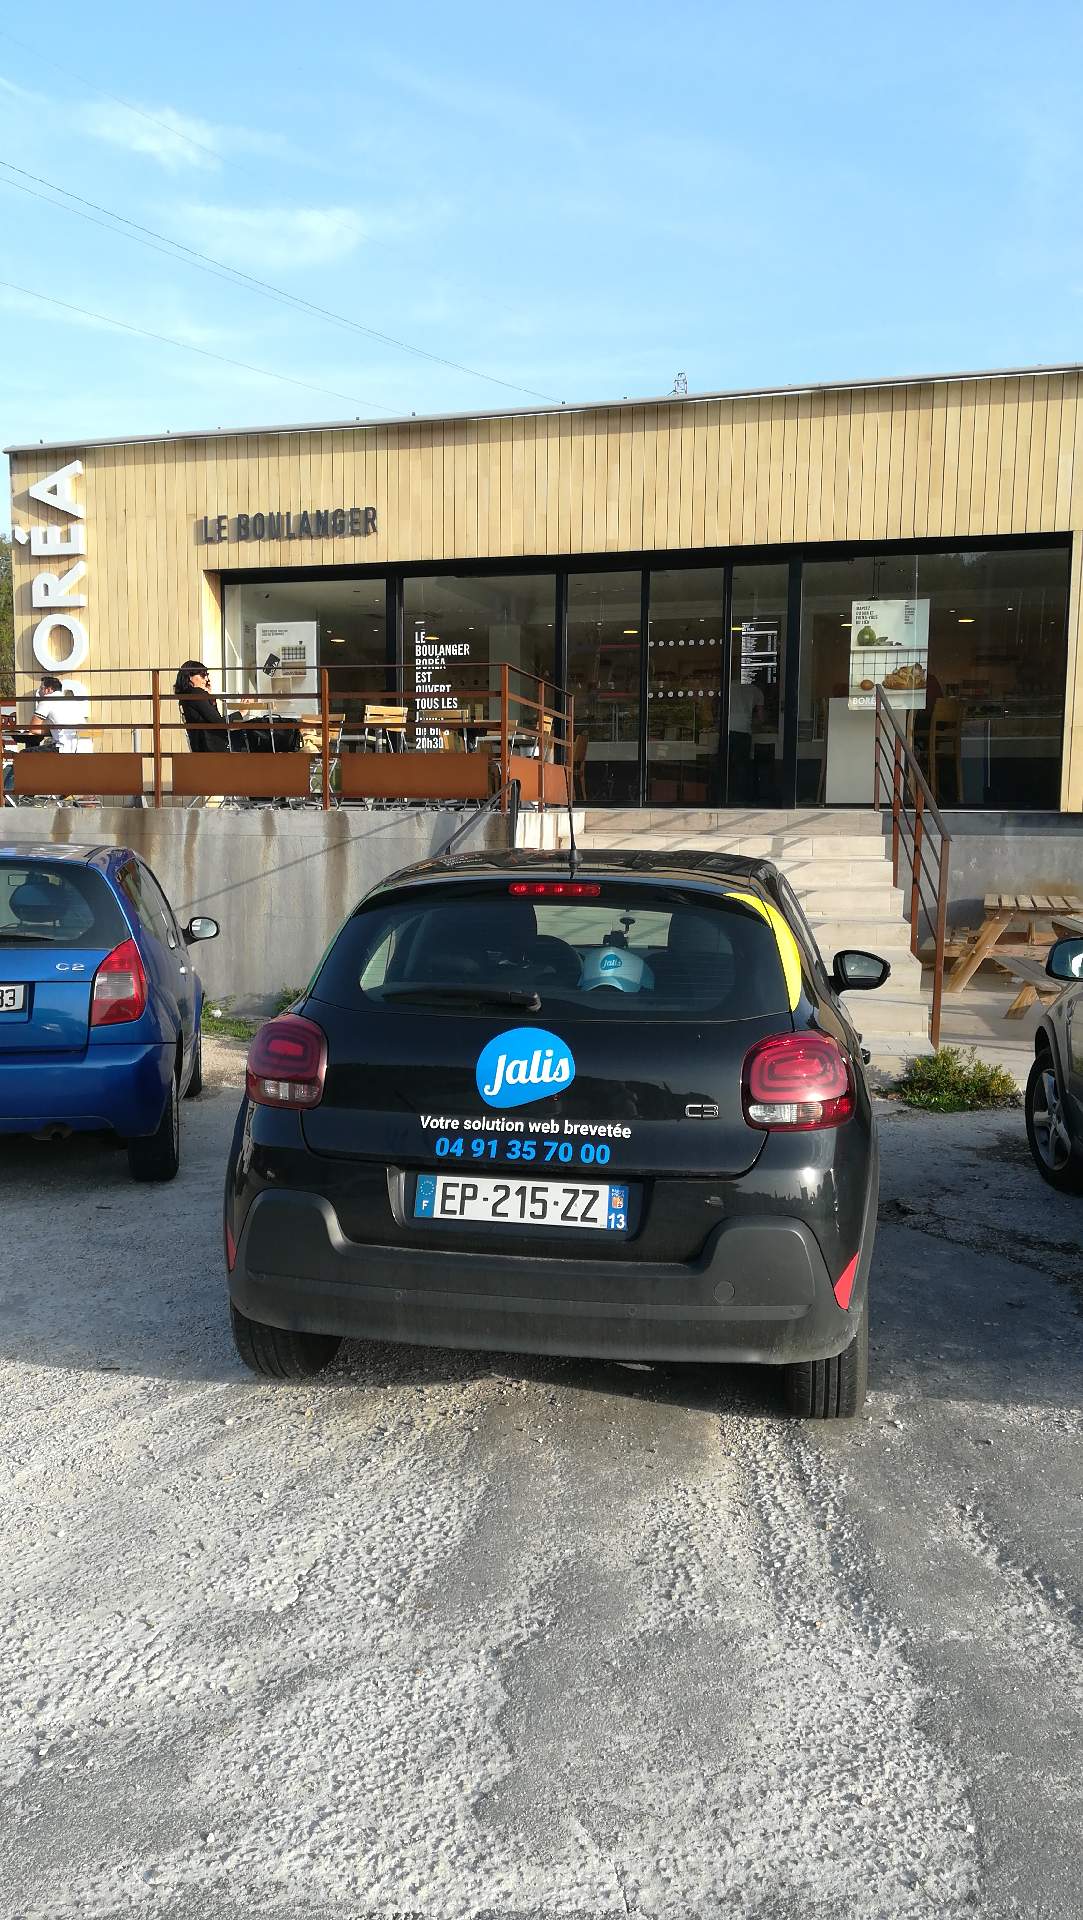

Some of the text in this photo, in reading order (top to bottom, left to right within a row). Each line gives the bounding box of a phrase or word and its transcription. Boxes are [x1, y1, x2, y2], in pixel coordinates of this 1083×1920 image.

[203, 506, 378, 542] LE BOULANGER
[15, 459, 88, 724] ORÉA
[415, 631, 426, 644] LE
[415, 643, 470, 657] BOULANGER
[415, 655, 447, 670] BORÉA
[415, 671, 433, 683] EST
[415, 697, 458, 710] TOUS LES
[415, 736, 444, 749] 20h30
[55, 962, 85, 971] C2
[483, 1048, 570, 1097] Jalis
[685, 1104, 719, 1118] C3
[420, 1115, 632, 1139] Votre solution web brevetée
[435, 1137, 611, 1165] 04 91 35 70 00
[422, 1200, 430, 1210] F
[439, 1182, 600, 1224] EP-215-ZZ
[608, 1212, 625, 1229] 13
